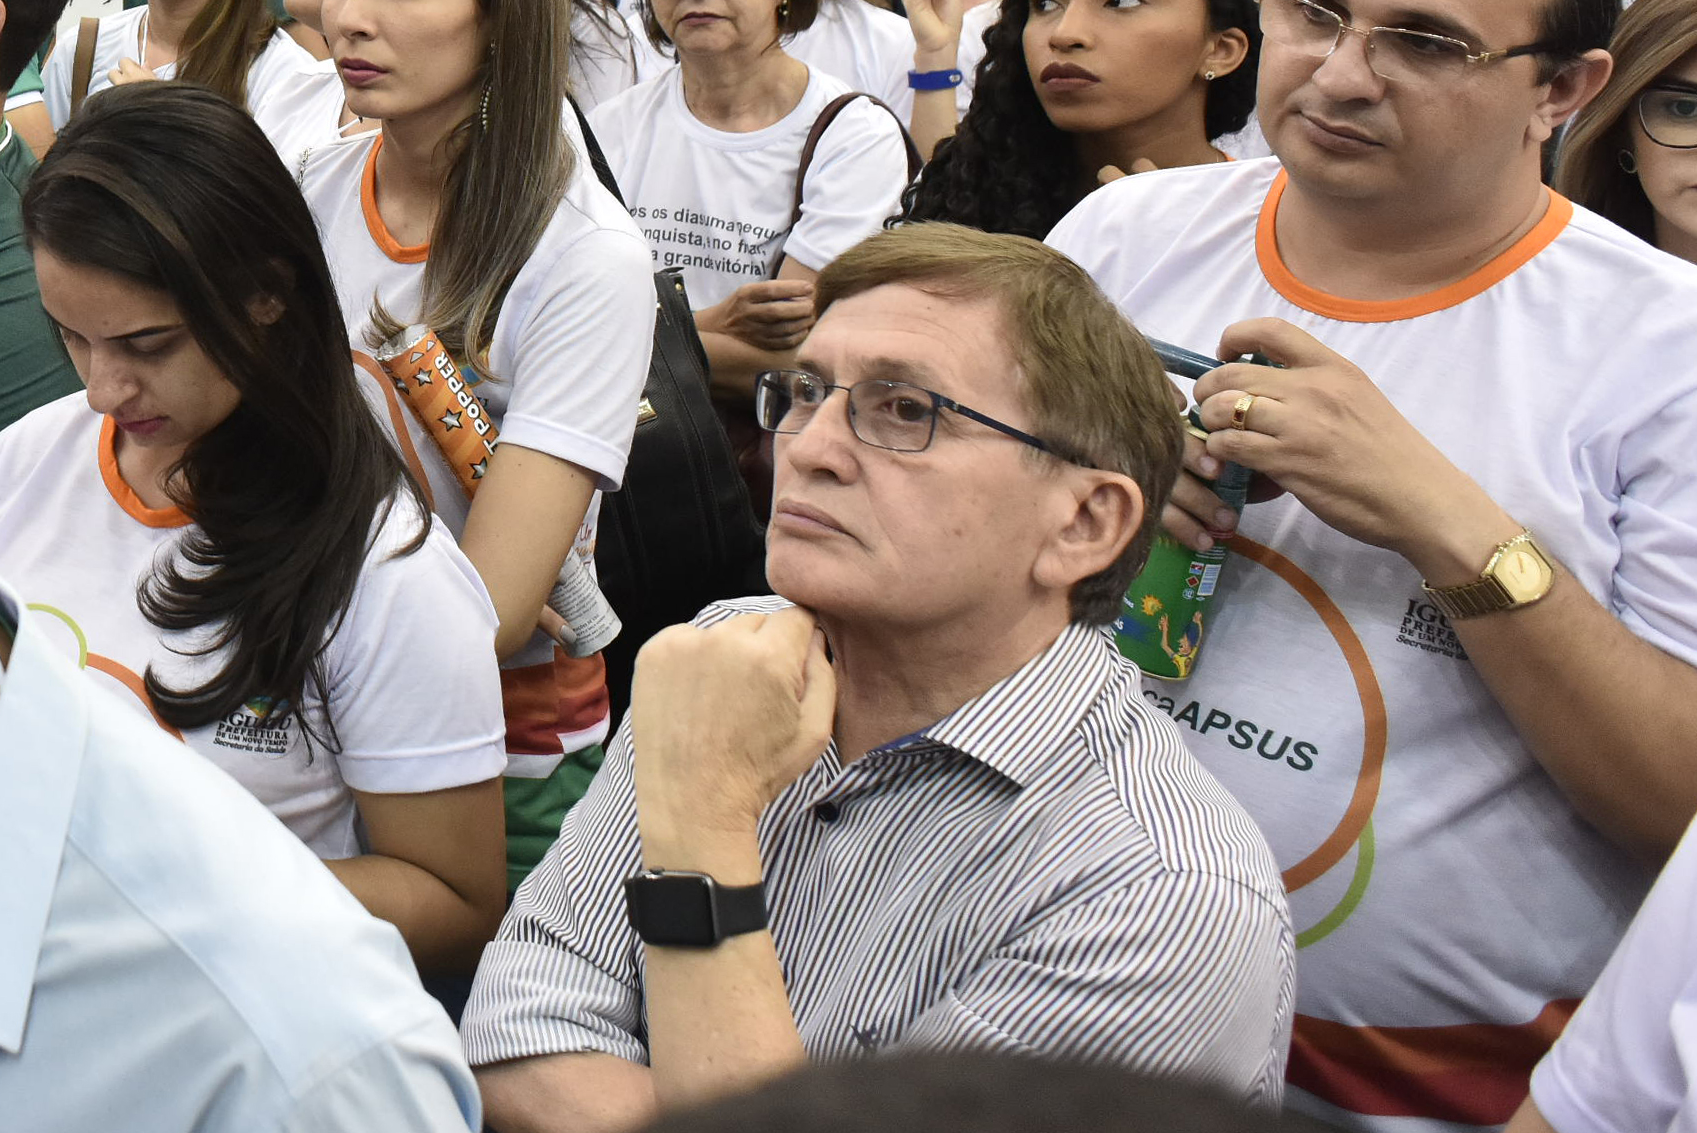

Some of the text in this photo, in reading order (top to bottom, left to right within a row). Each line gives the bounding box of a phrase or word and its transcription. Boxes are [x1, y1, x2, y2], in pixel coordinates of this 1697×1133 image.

[652, 209, 668, 219] os
[639, 227, 706, 249] nquista,
[434, 349, 491, 437] POPPER
[218, 722, 288, 740] PREFEITURA
